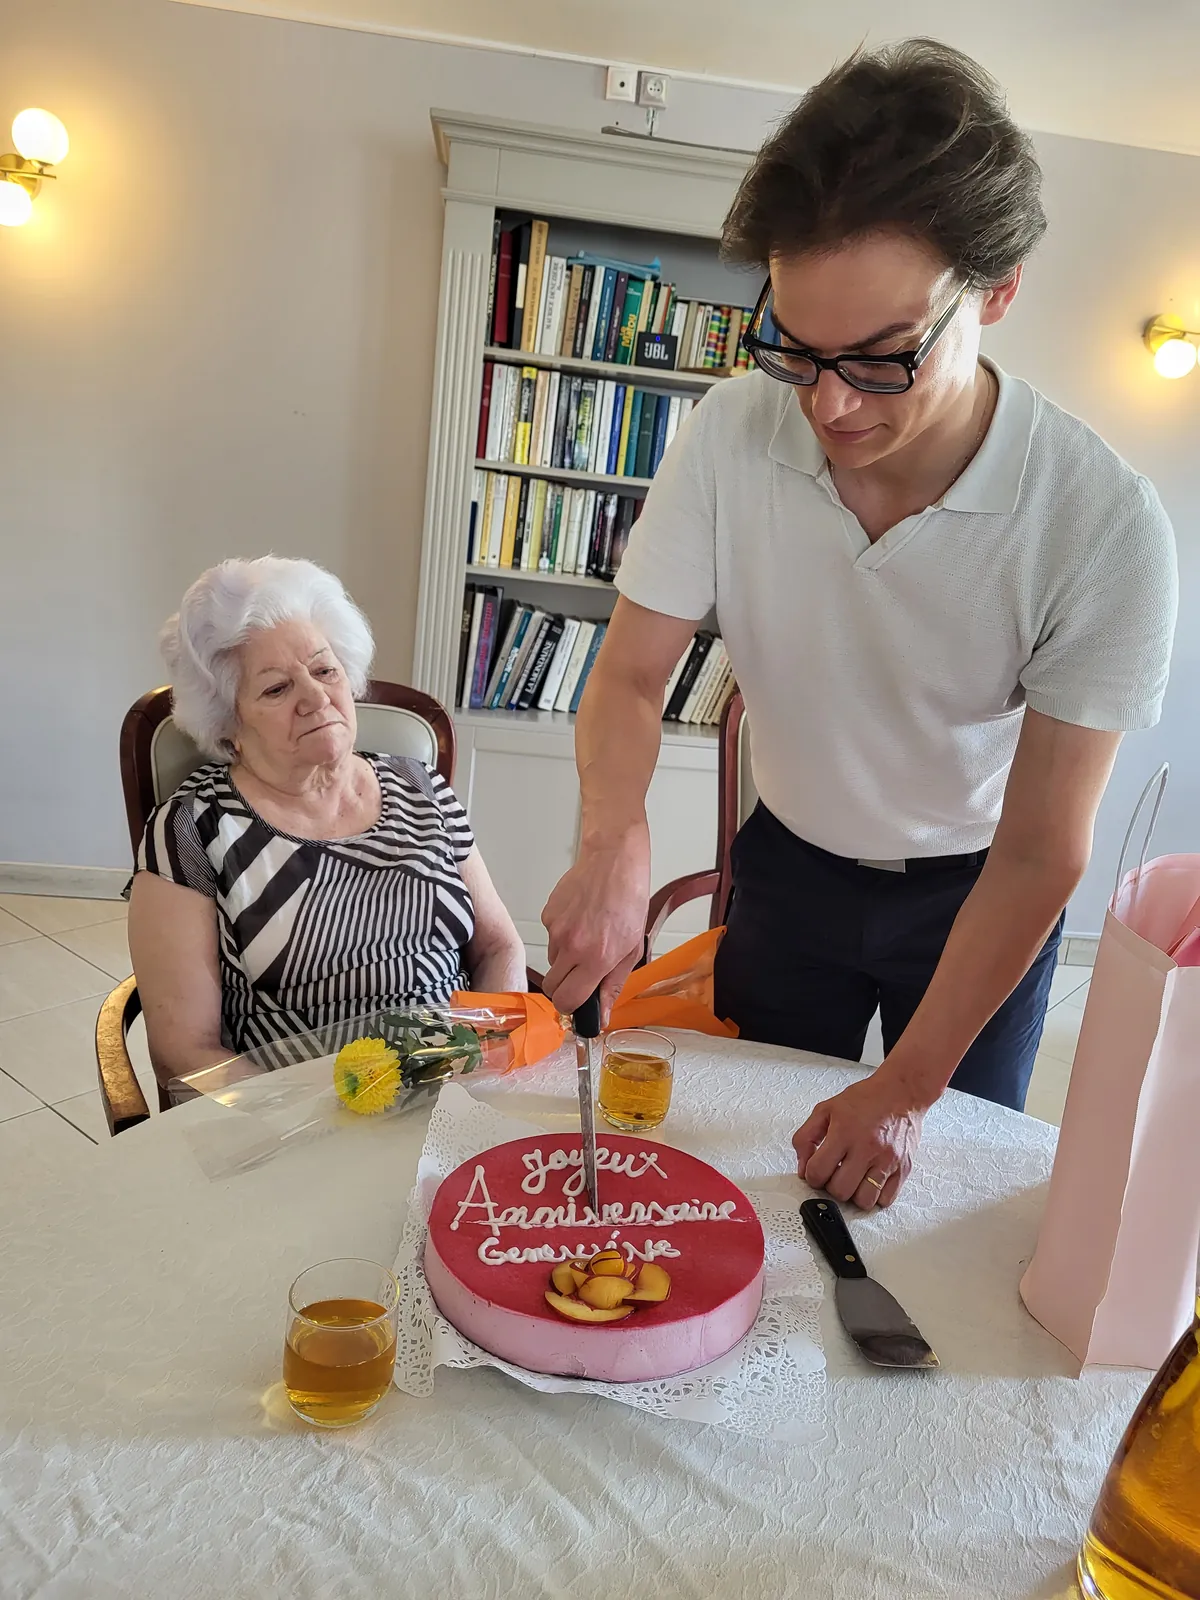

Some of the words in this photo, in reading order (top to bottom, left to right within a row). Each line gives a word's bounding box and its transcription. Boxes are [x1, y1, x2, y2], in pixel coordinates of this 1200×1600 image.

[644, 342, 669, 360] JBL
[530, 640, 552, 681] MONDAINE
[449, 1165, 736, 1236] Anniversaire
